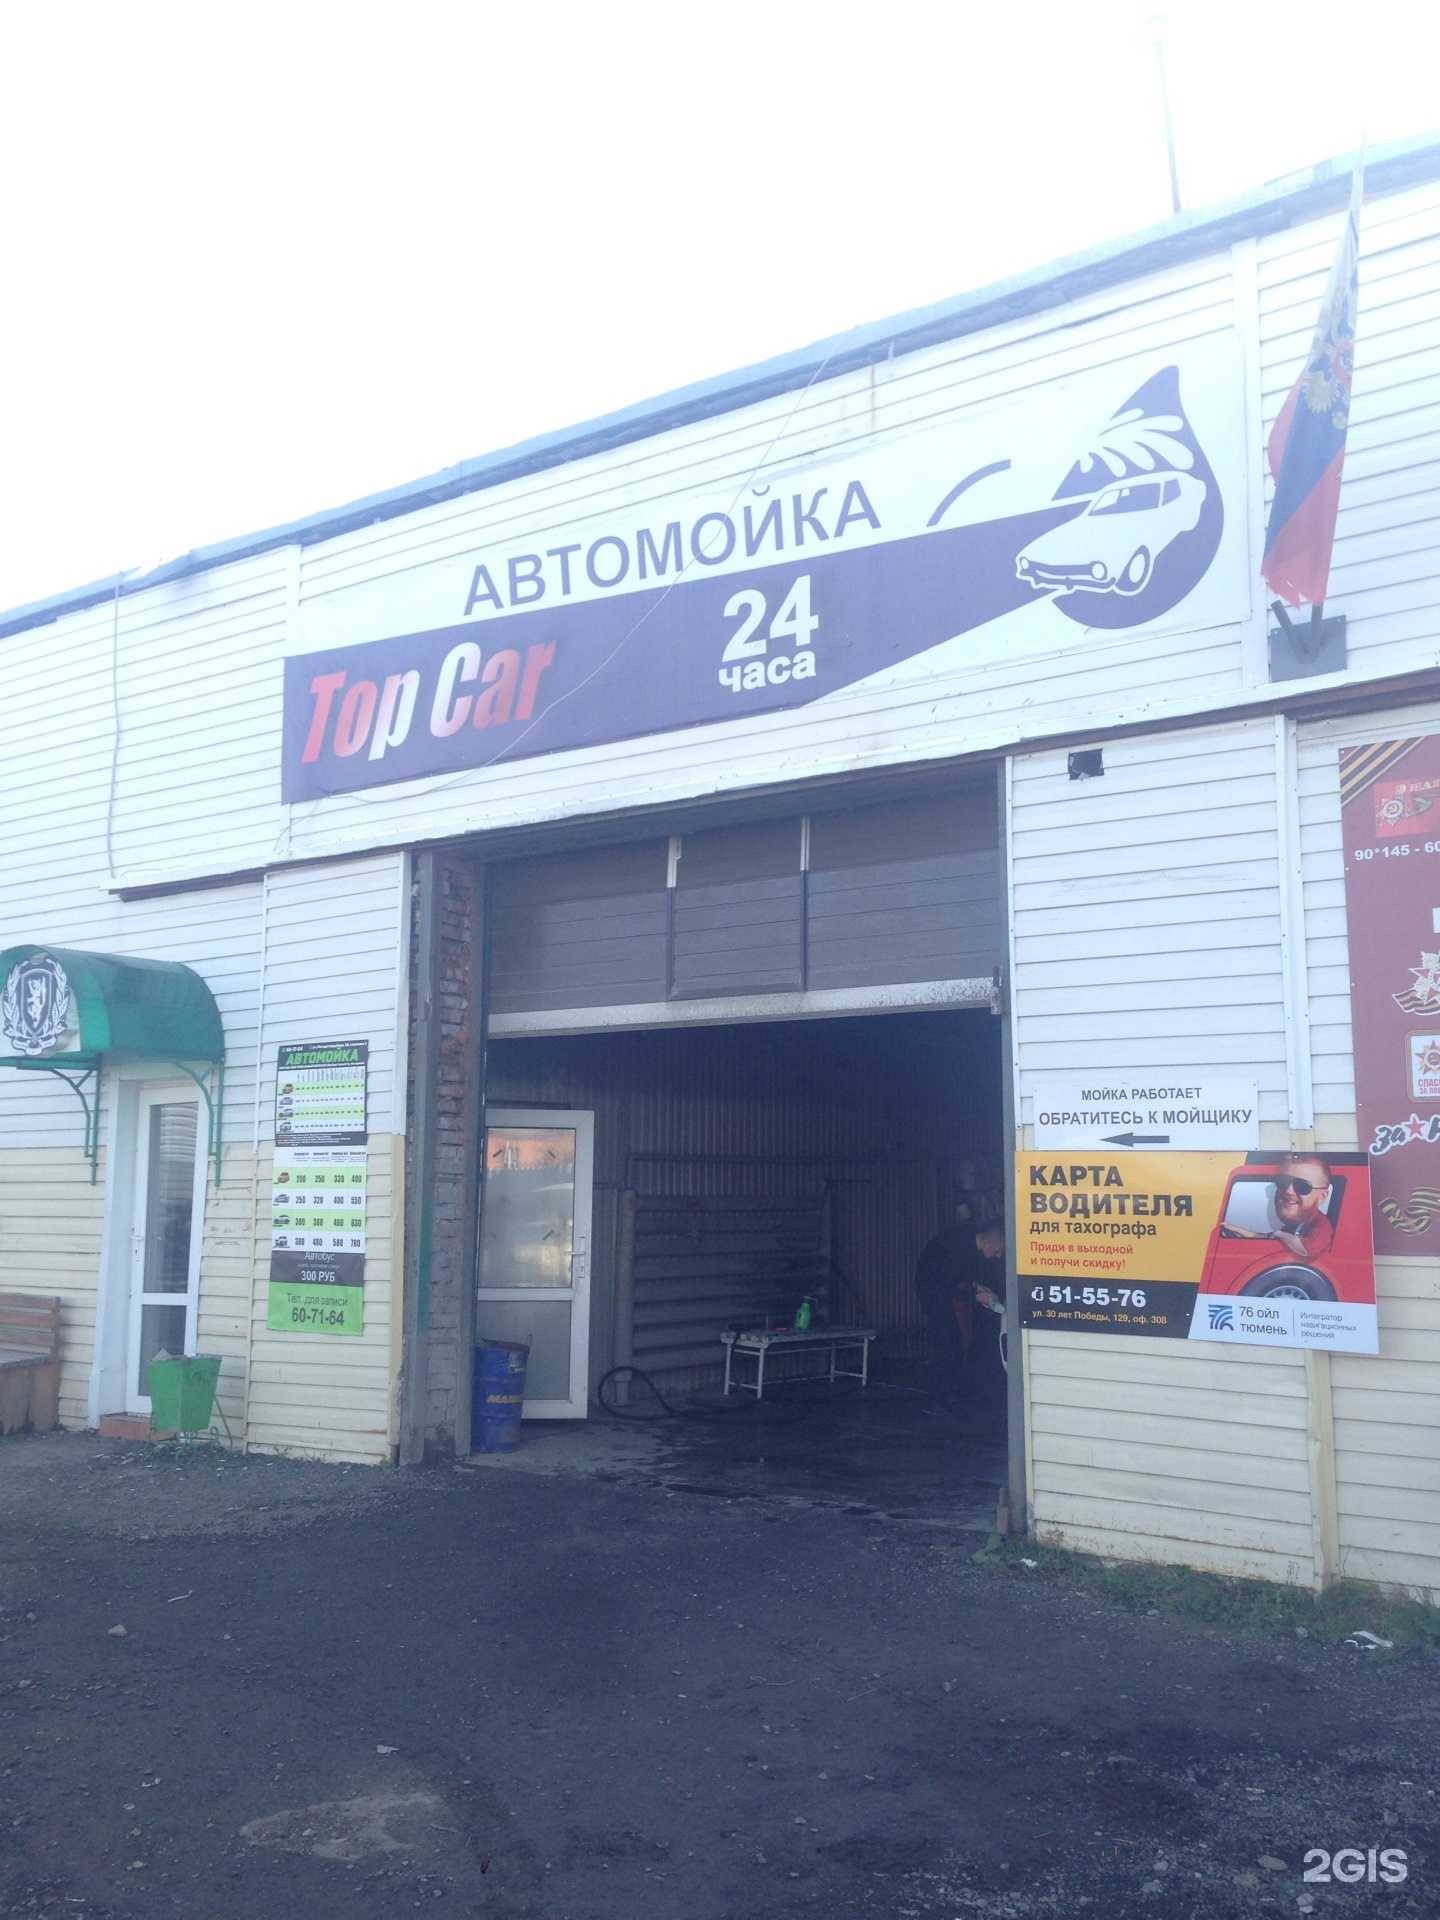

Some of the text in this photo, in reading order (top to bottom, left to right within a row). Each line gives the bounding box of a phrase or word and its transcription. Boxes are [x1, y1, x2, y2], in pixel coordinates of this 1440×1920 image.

[463, 479, 883, 616] АВТОМОЙКА
[721, 575, 820, 664] 24
[718, 650, 817, 694] часа
[300, 638, 558, 765] Top Car
[286, 1047, 359, 1066] АВТОМОЙКА
[1081, 1087, 1203, 1101] МОЙКА РАБОТАЕТ
[1039, 1106, 1253, 1126] ОБРАТИТЕСЬ К МОЙЩИКУ
[1029, 1165, 1124, 1187] КАРТА
[1029, 1192, 1193, 1219] ВОДИТЕЛЯ
[1030, 1221, 1157, 1239] для тахографа
[1030, 1241, 1065, 1254] Приди
[1077, 1243, 1134, 1255] выходной
[1040, 1259, 1080, 1270] получи
[1082, 1259, 1126, 1271] скидку!
[300, 1270, 336, 1282] 300 РУБ
[1049, 1285, 1147, 1308] 51-55-76
[291, 1306, 345, 1326] 60-71-64
[1032, 1310, 1043, 1319] ул.
[1046, 1310, 1057, 1318] 30
[1058, 1311, 1073, 1319] лет
[1240, 1305, 1280, 1320] 76 ойл
[1240, 1323, 1288, 1336] тюмень
